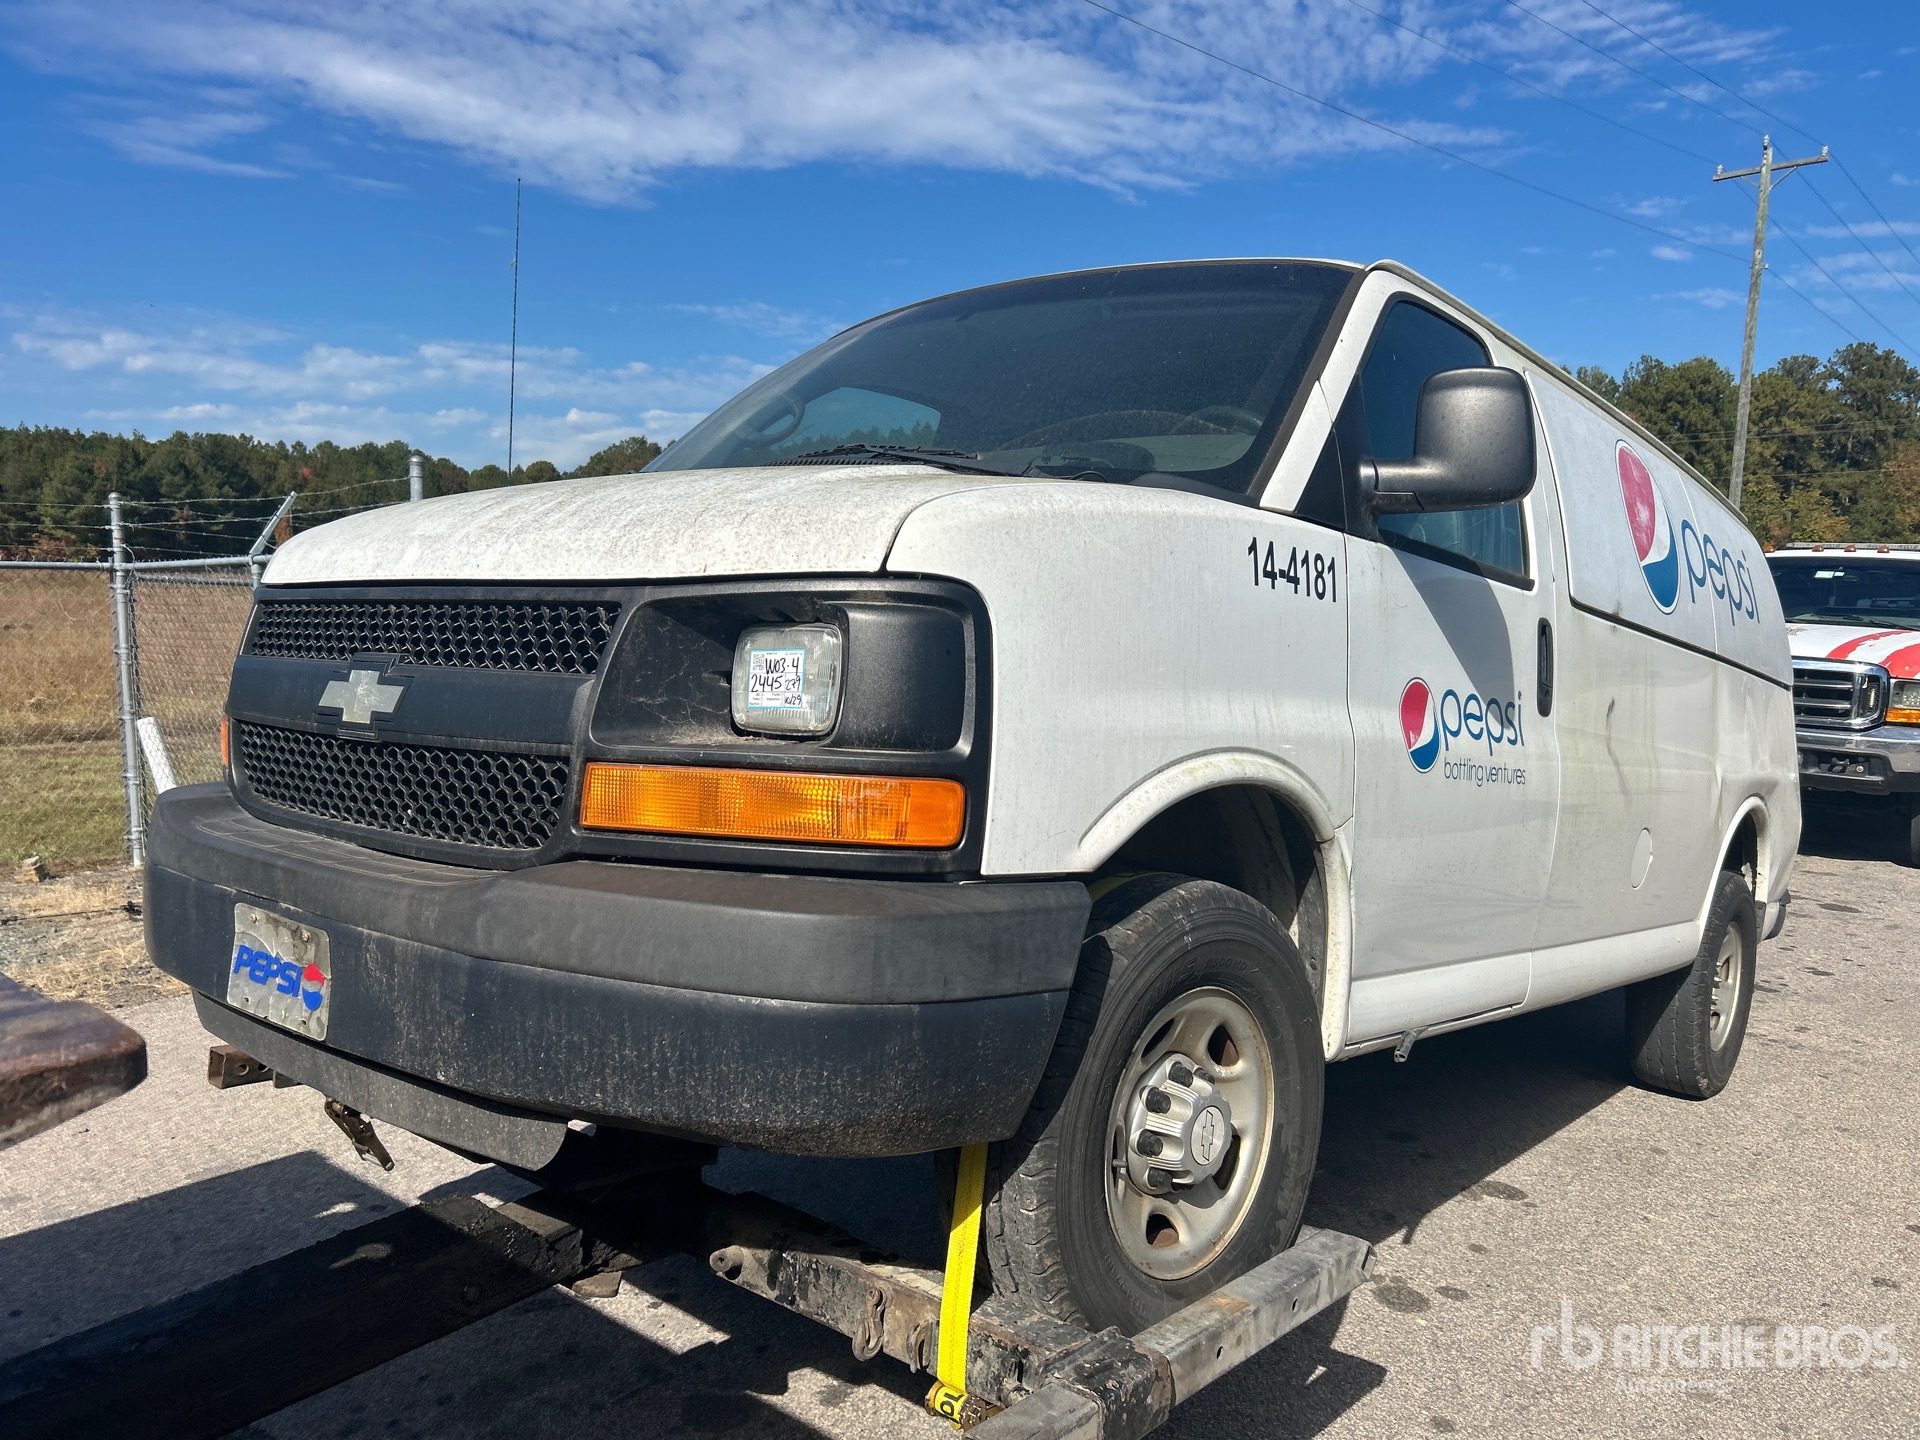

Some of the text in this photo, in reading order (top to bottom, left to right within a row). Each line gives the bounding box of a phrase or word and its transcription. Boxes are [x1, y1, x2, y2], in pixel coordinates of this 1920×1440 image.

[1248, 536, 1336, 602] 14-4181
[1681, 519, 1760, 626] pepsi
[751, 673, 783, 692] 2445
[1440, 689, 1525, 756] pepsi
[1444, 757, 1526, 787] bottling ventures
[233, 944, 302, 998] PEPSI
